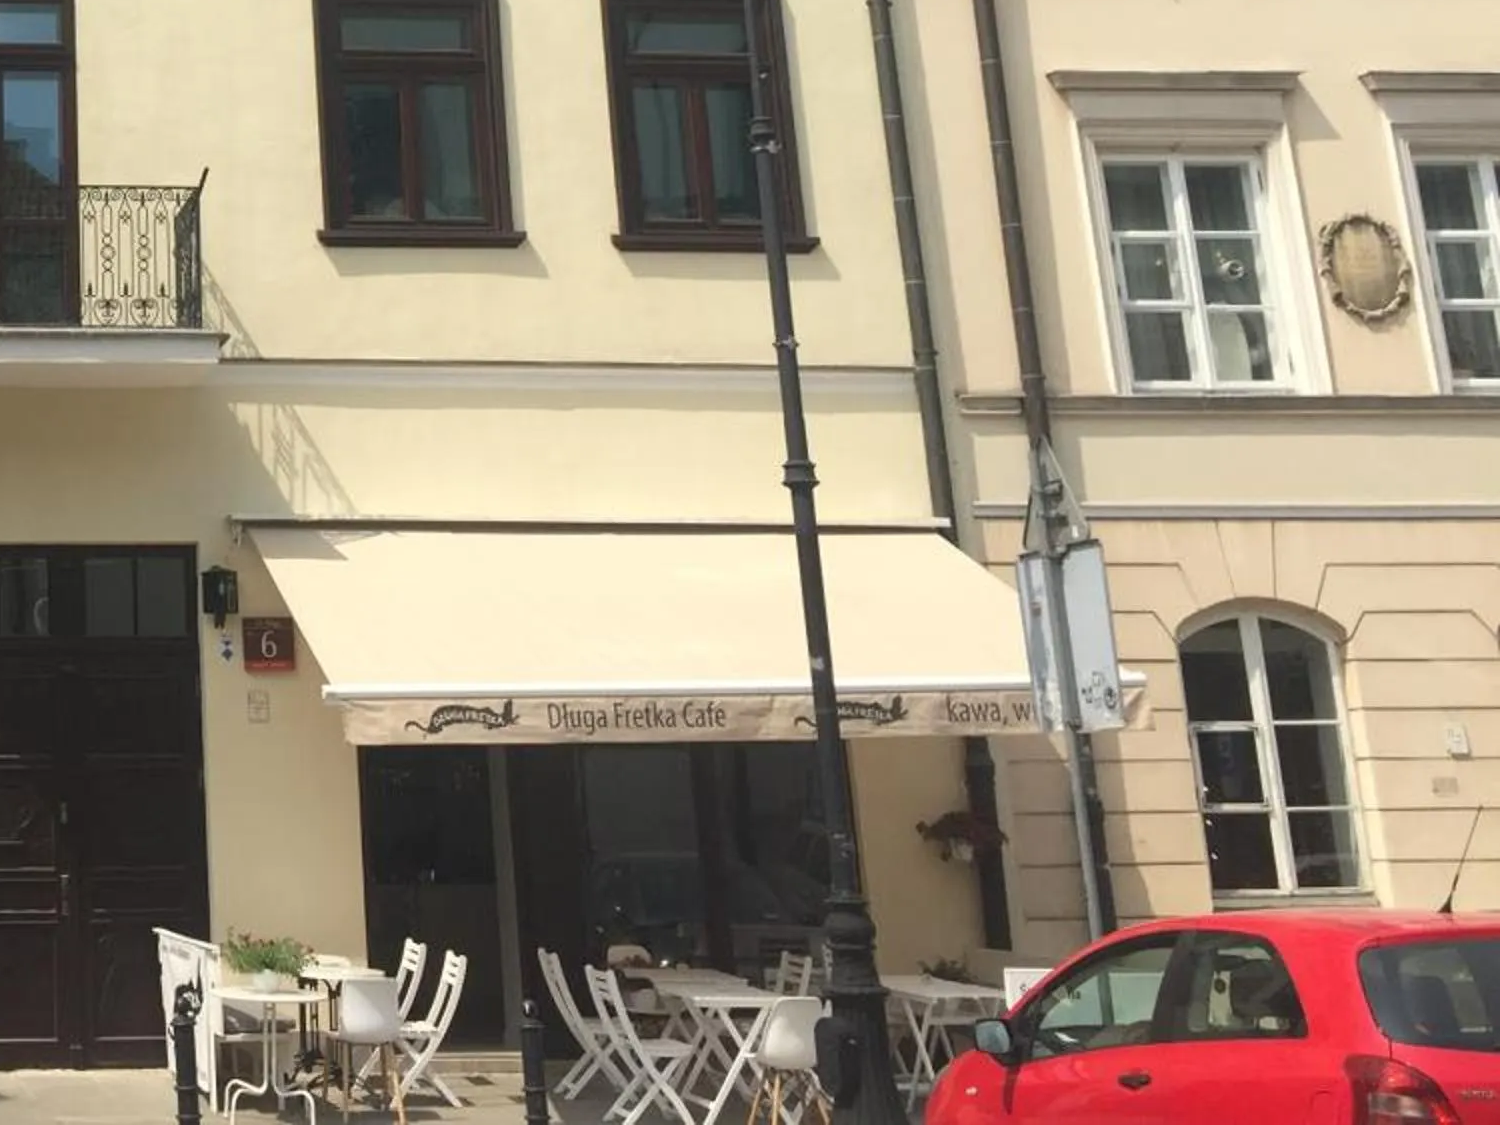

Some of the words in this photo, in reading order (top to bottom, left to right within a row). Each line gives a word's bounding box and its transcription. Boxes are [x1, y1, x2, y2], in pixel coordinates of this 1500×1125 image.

[261, 630, 277, 658] 6
[548, 702, 607, 735] Długa
[612, 702, 676, 729] Fretka
[946, 695, 1008, 725] kawa,
[1012, 702, 1036, 722] w
